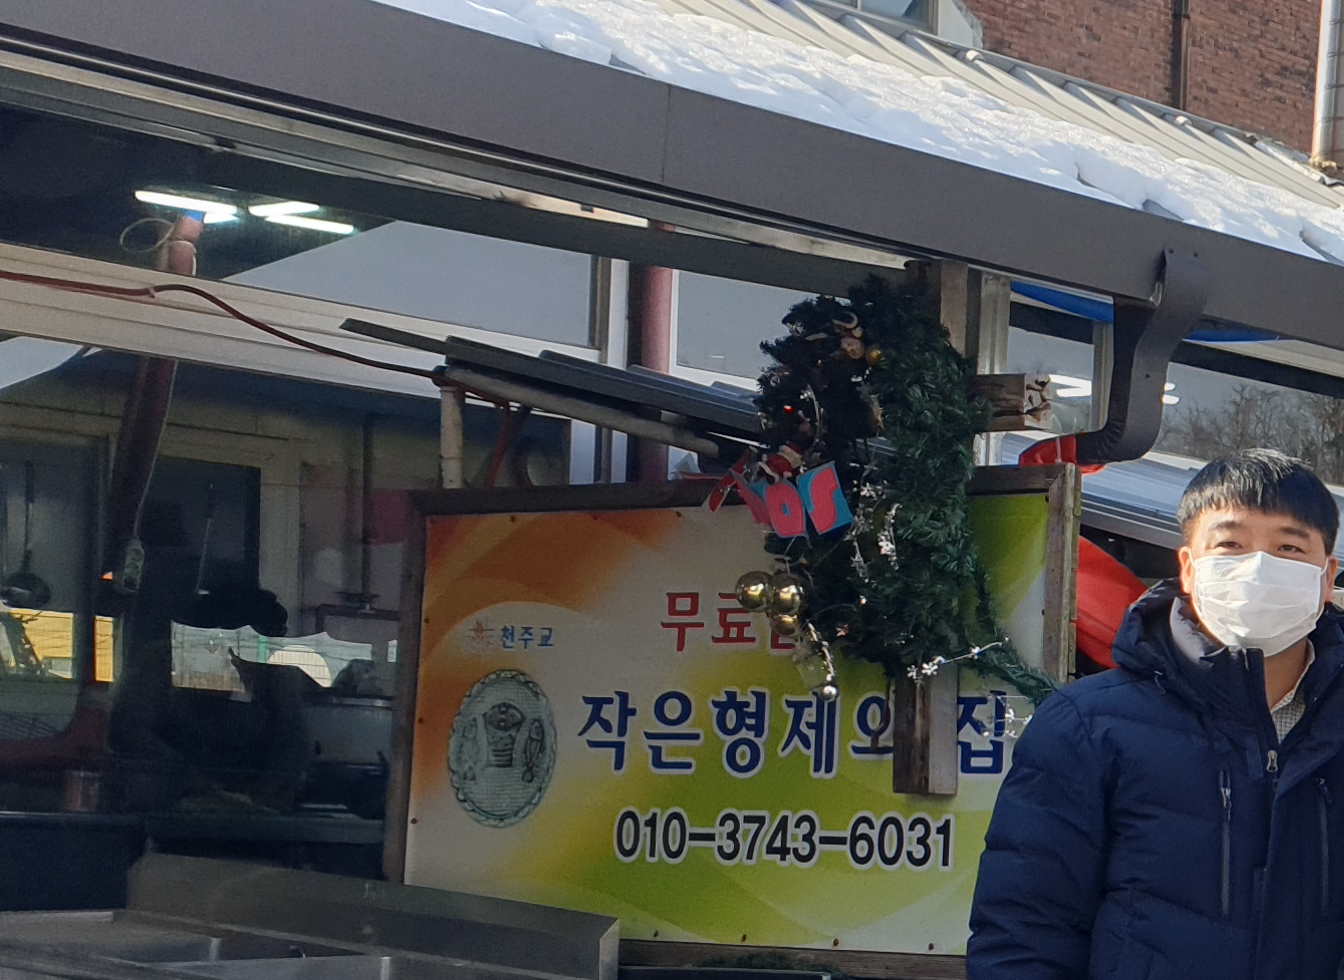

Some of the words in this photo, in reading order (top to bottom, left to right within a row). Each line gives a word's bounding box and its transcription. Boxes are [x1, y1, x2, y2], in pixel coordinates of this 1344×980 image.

[501, 625, 554, 648] 천주교
[660, 592, 797, 653] 무료
[615, 812, 955, 867] 010-3743-6031
